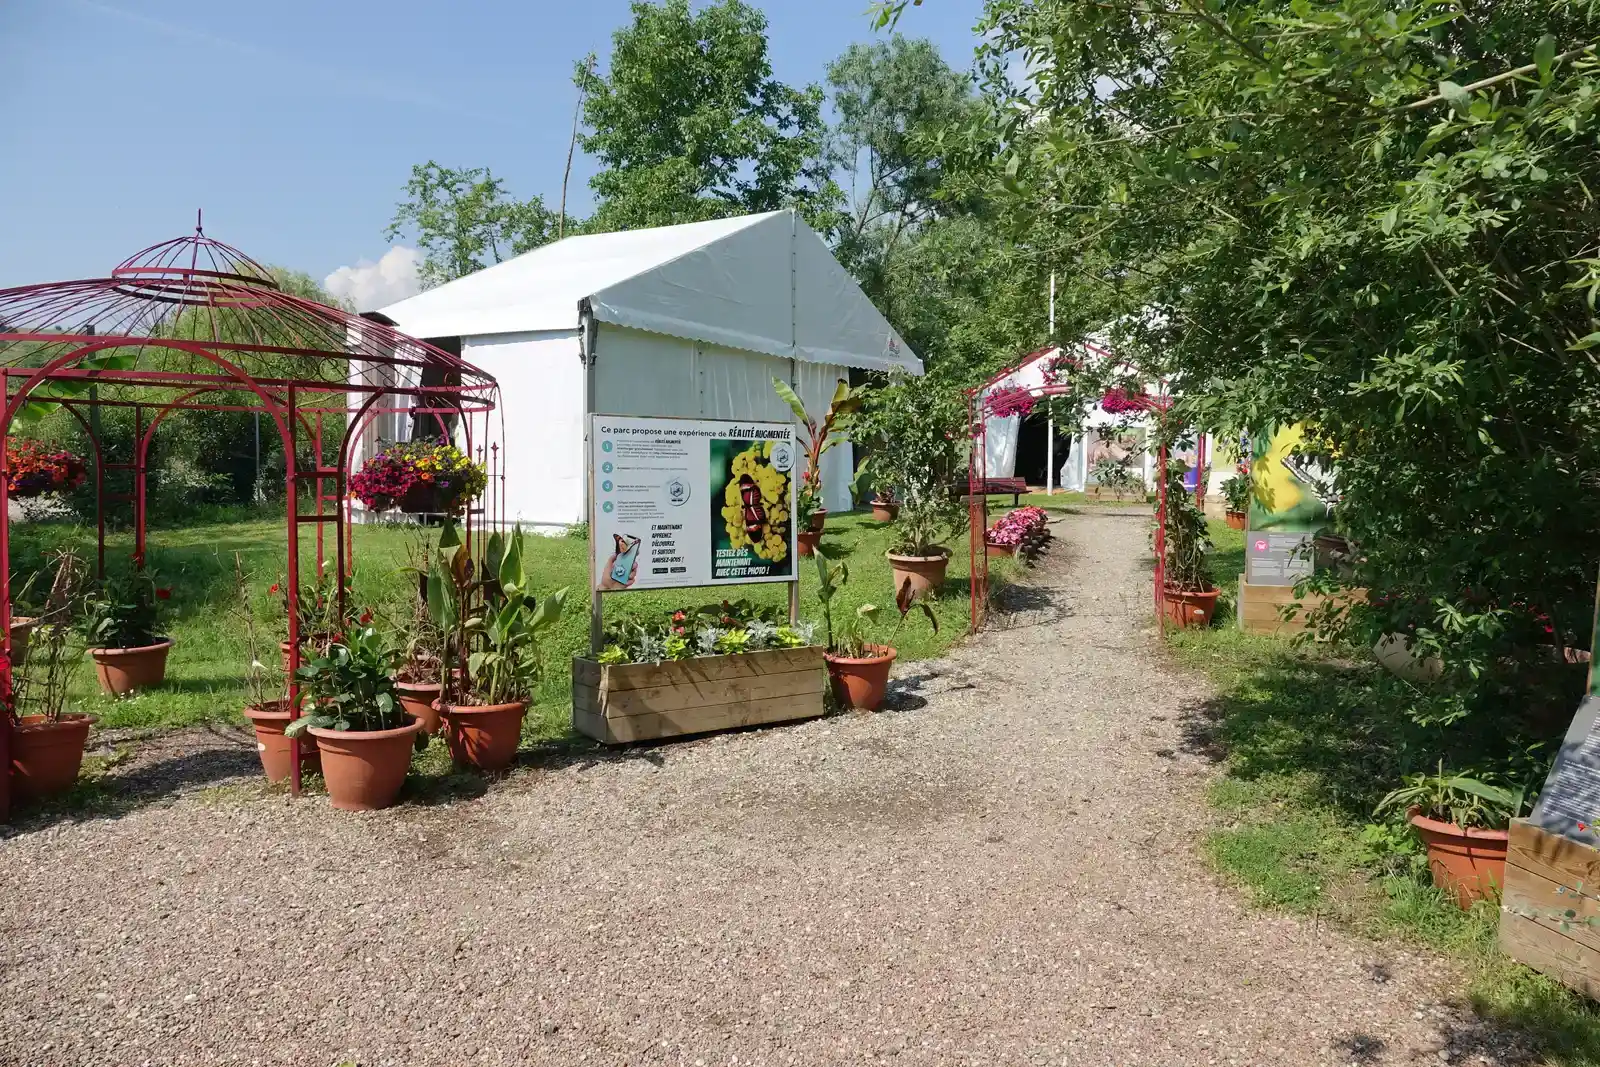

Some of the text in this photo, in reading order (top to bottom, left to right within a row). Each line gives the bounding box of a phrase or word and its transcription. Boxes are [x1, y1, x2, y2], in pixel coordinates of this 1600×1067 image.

[632, 427, 662, 436] propose
[678, 429, 716, 437] expérience
[729, 426, 755, 438] RÉALITÉ
[755, 428, 791, 439] AUGMENTÉE
[716, 547, 748, 557] TESTEZ DÈS
[715, 558, 752, 567] MAINTENANT
[715, 568, 730, 576] AVEC
[730, 567, 748, 576] CETTE
[747, 566, 766, 575] PHOTO
